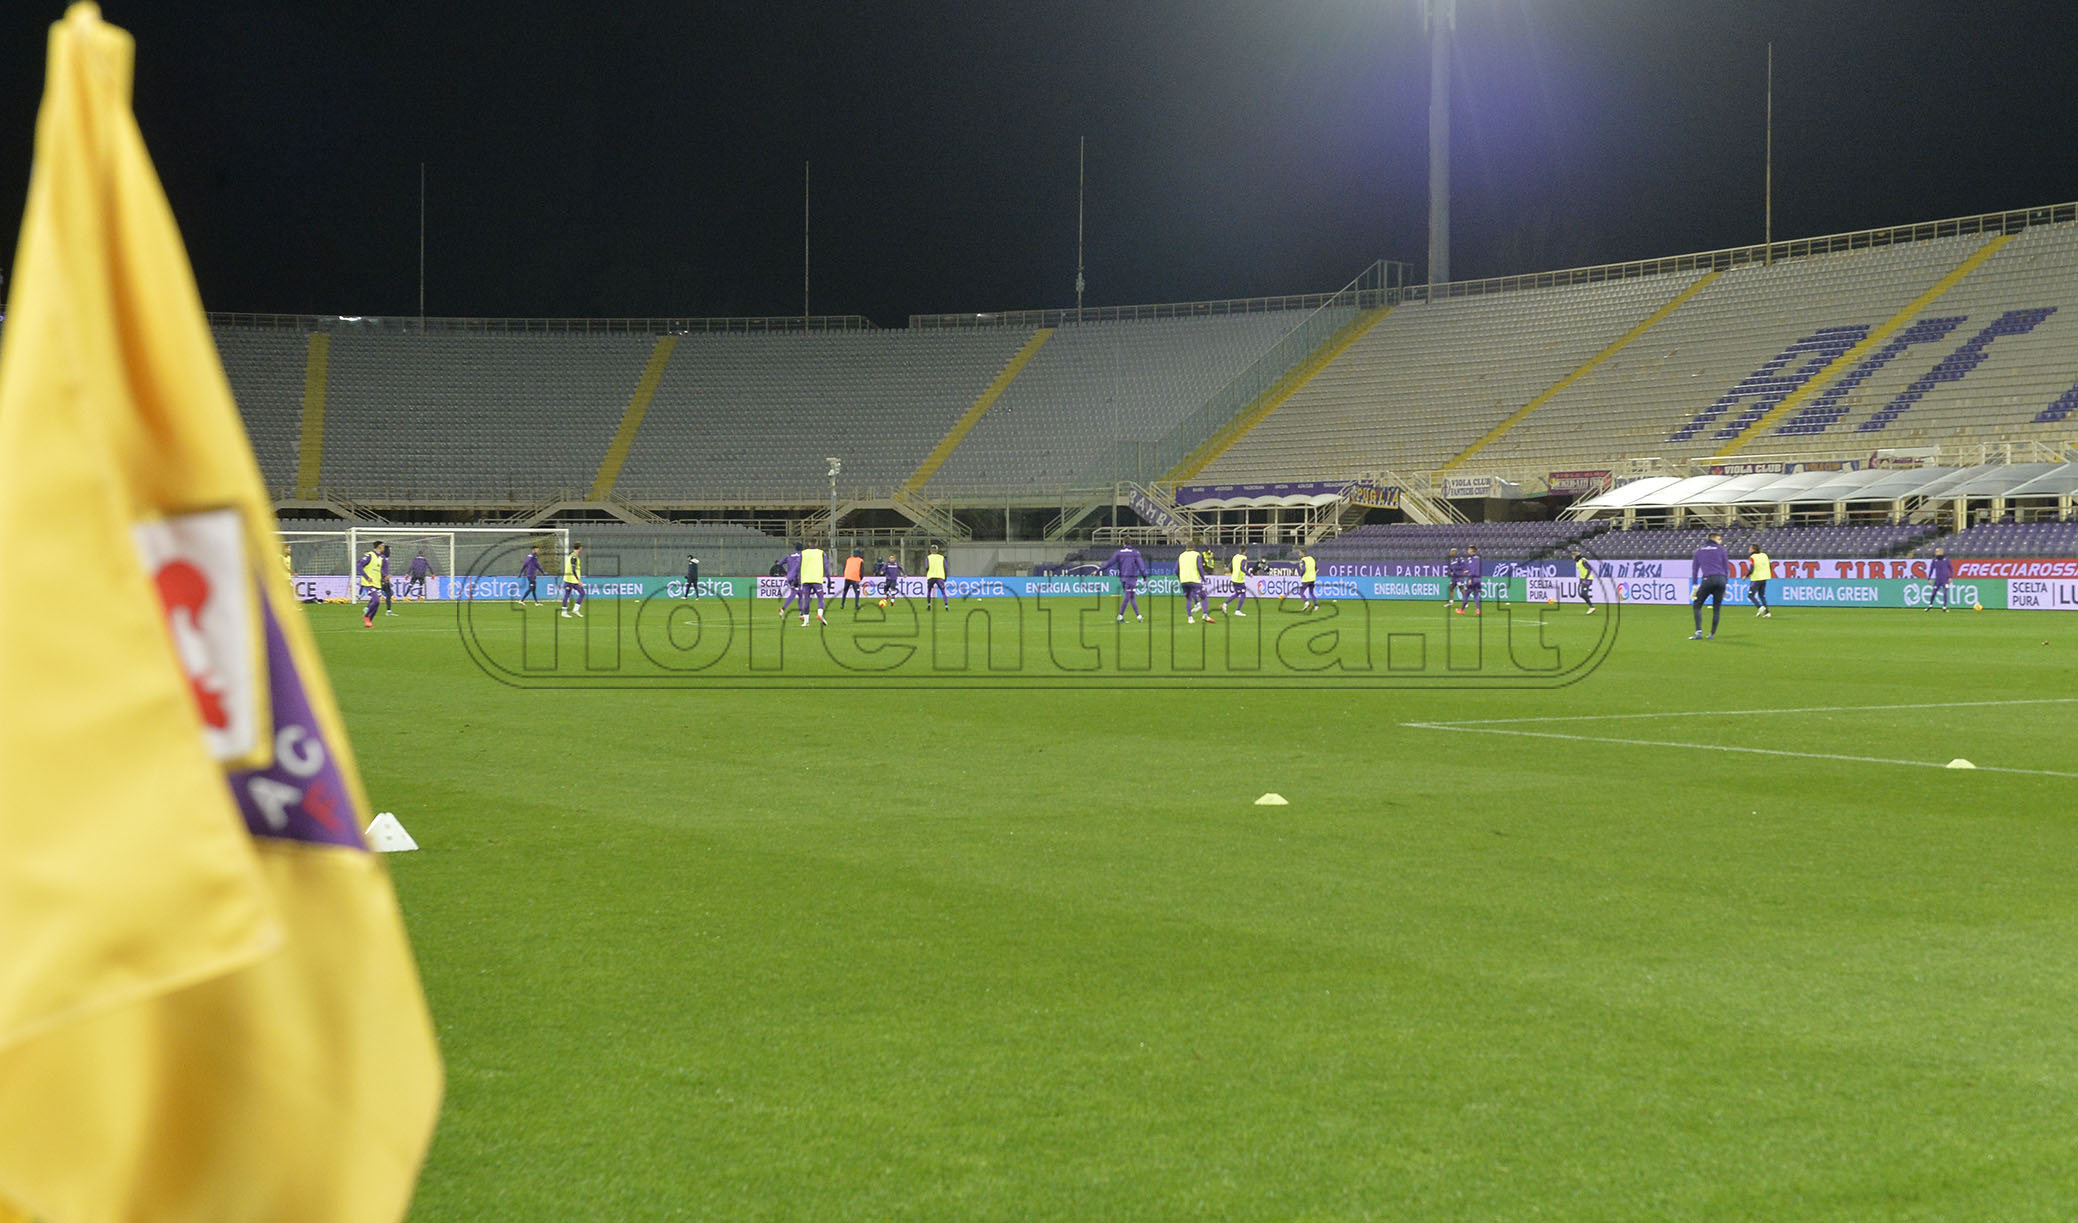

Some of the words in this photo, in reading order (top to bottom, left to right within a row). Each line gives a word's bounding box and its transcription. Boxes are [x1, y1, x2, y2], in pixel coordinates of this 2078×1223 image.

[1724, 465, 1752, 475] VIOLA
[1754, 463, 1781, 473] CLUB
[1473, 477, 1491, 486] CLUB
[1356, 487, 1399, 503] PUGLIA
[1329, 565, 1390, 576] OFFICIAL
[1396, 565, 1448, 576] PARTNE
[1633, 561, 1662, 577] FASSA
[1835, 561, 1927, 578] TIRES
[464, 577, 521, 598] estra
[602, 583, 643, 596] GREEN
[760, 579, 789, 588] SCELTA
[958, 577, 1004, 596] estra
[1025, 582, 1071, 594] ENERGIA
[1075, 582, 1110, 593] GREEN
[1146, 577, 1181, 595] estra
[1216, 581, 1236, 594] LUC
[1267, 577, 1300, 596] estra
[1321, 577, 1358, 597] estra
[1374, 583, 1410, 596] ENERGIA
[1411, 583, 1440, 596] GREEN
[1529, 580, 1552, 589] SCELTA
[2012, 582, 2048, 593] SCELTA
[760, 589, 782, 598] PURA
[1529, 591, 1548, 600] PURA
[1631, 580, 1677, 601] estra
[1782, 586, 1835, 601] ENERGIA
[1838, 587, 1879, 602] GREEN
[2012, 595, 2040, 606] PURA
